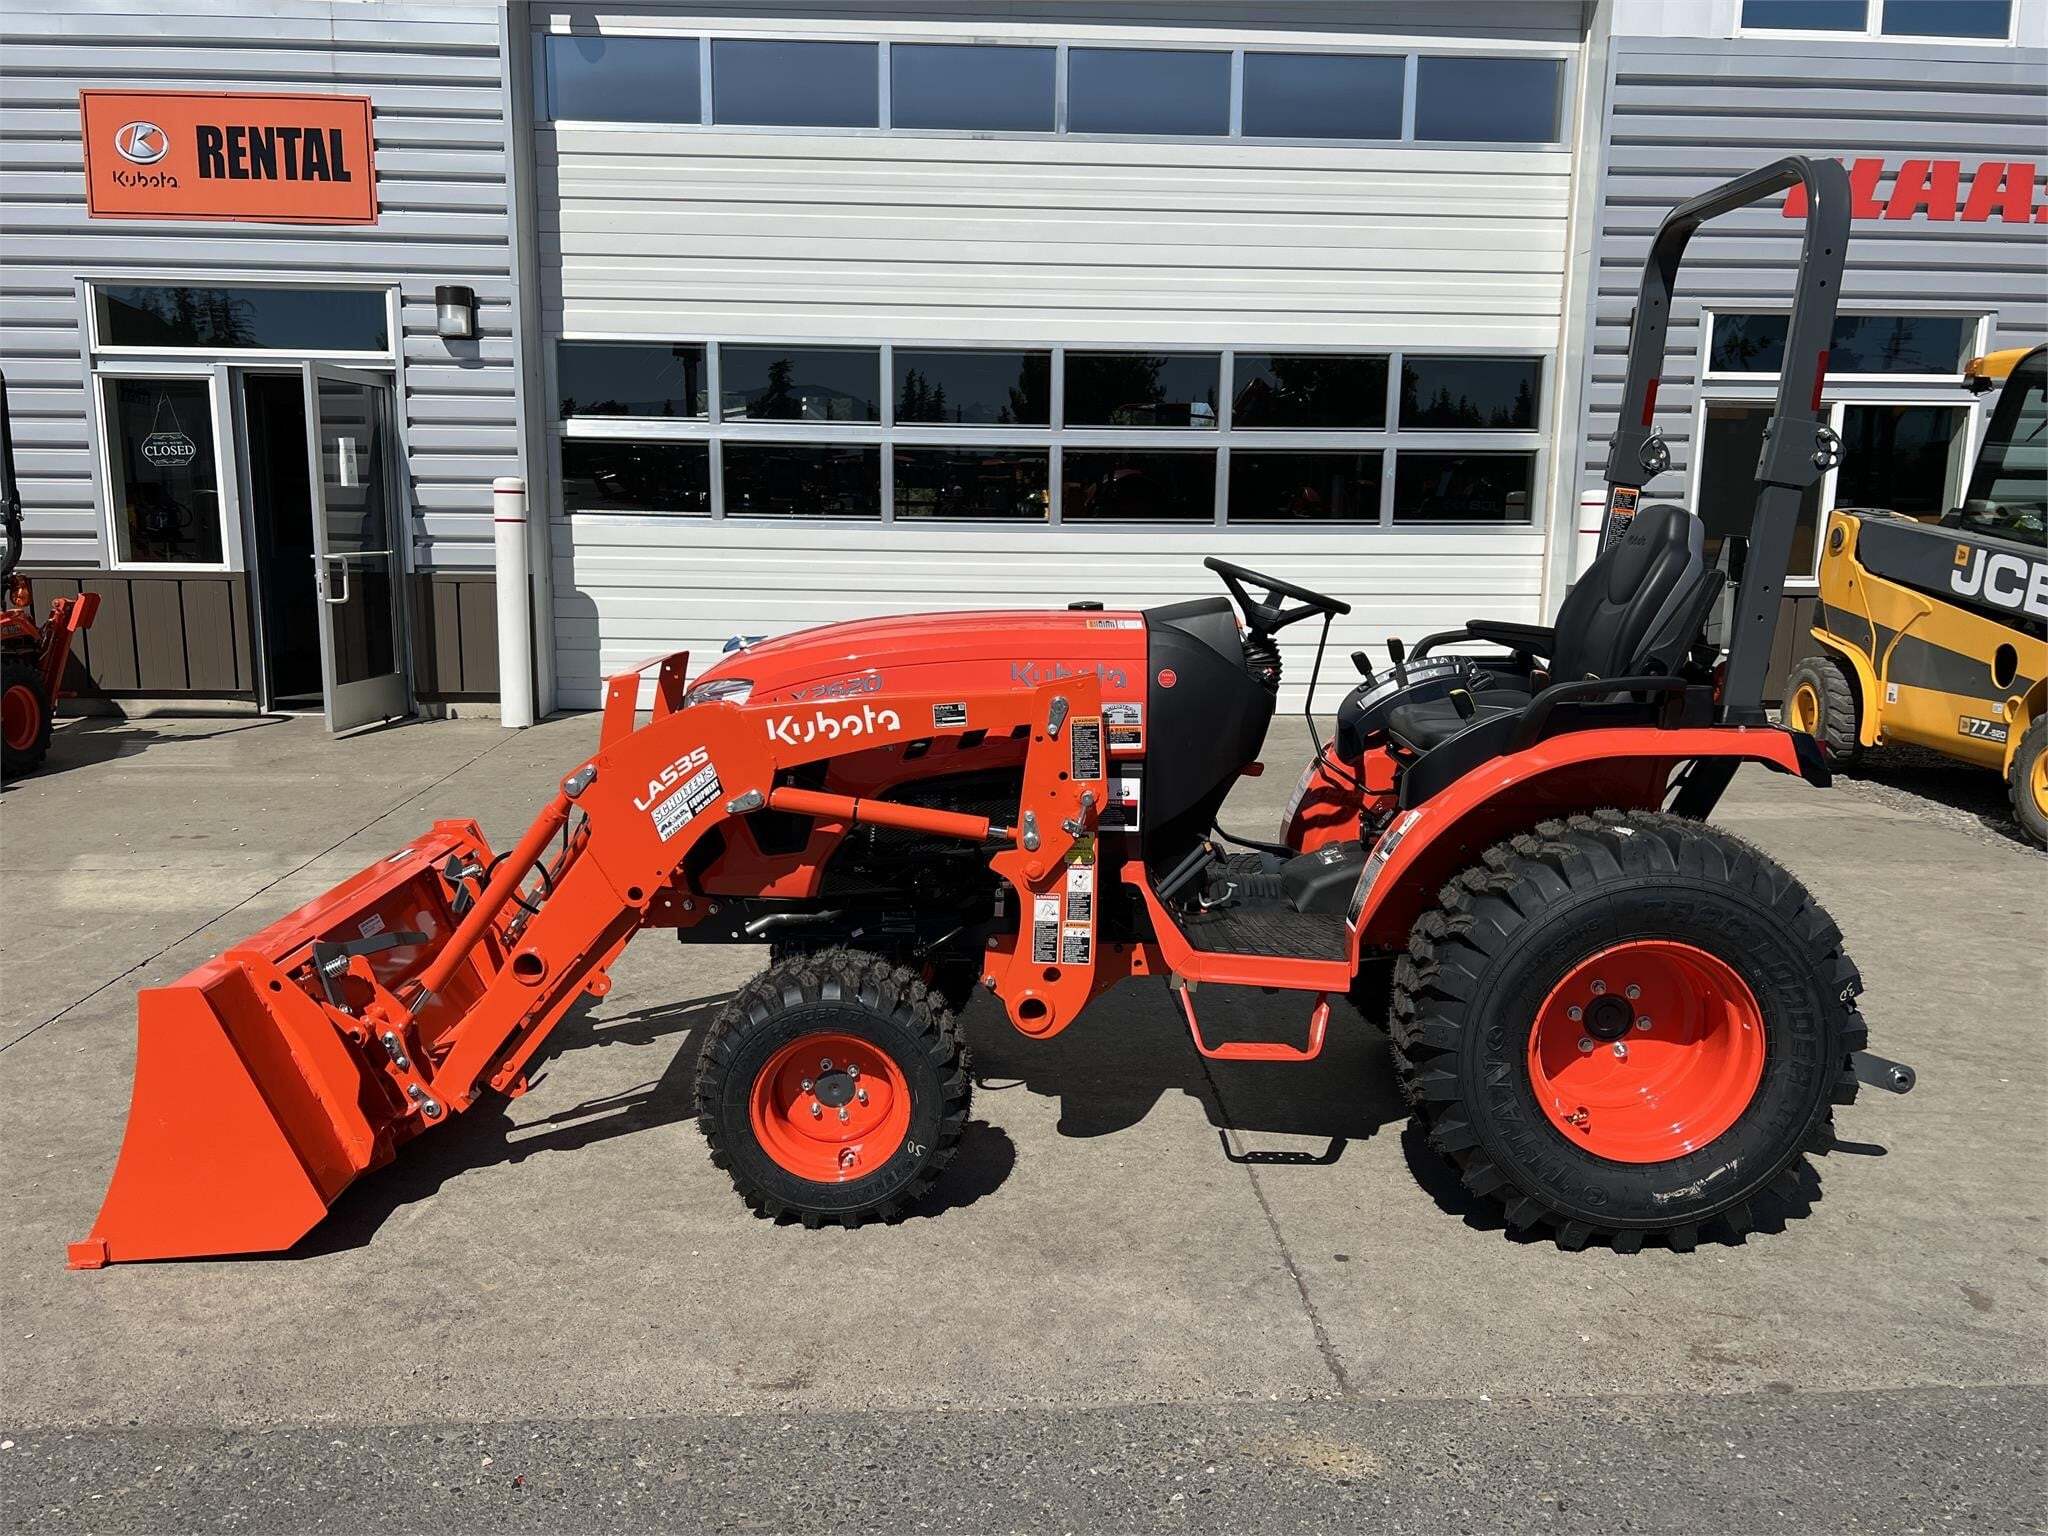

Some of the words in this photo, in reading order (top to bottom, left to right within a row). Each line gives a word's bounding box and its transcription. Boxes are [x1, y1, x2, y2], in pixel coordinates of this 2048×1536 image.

[112, 170, 179, 189] Kubota
[196, 125, 352, 182] RENTAL
[1782, 157, 2048, 225] LAA
[144, 445, 194, 457] CLOSED
[766, 704, 901, 746] Kubota
[633, 745, 709, 811] LA535
[655, 767, 715, 823] SCHOLTEN'S
